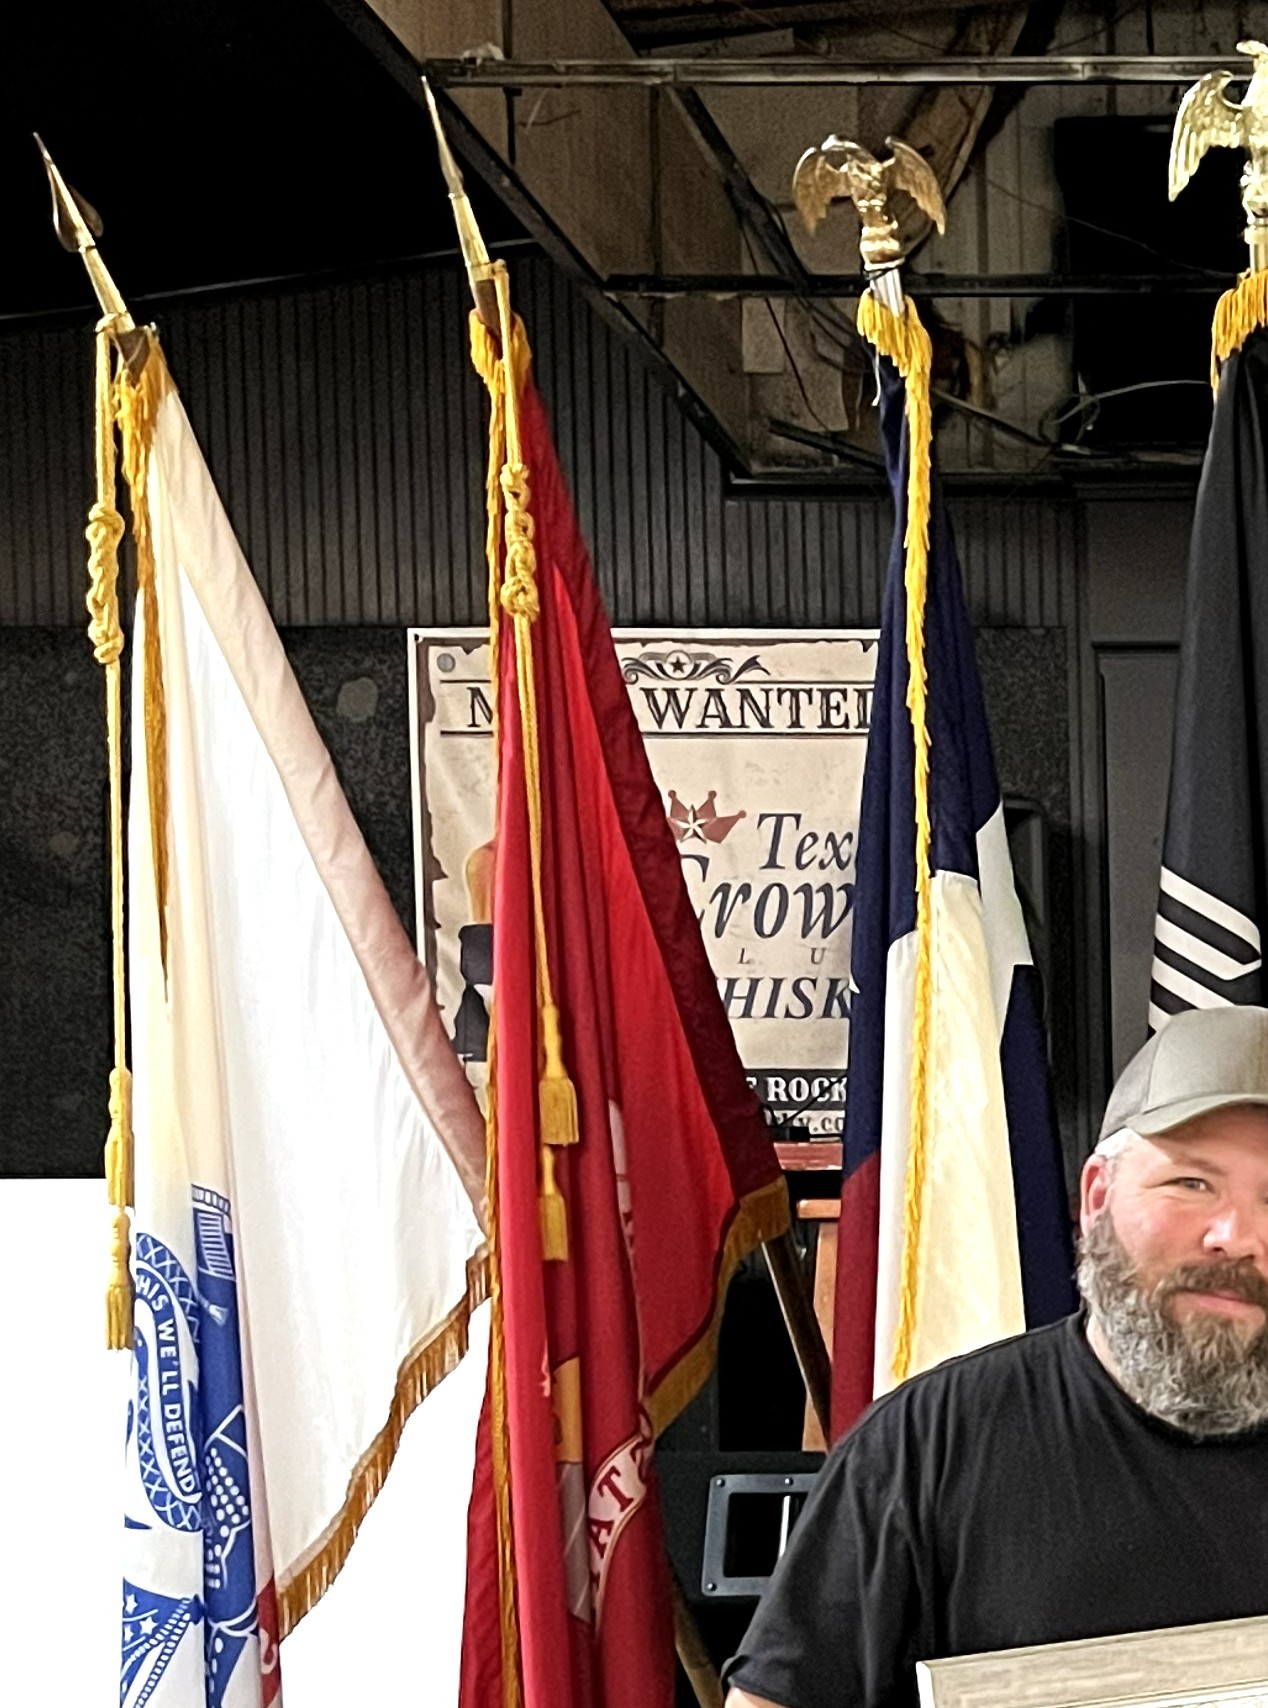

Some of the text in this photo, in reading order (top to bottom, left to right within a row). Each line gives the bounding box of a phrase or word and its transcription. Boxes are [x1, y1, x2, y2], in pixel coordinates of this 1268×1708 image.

[757, 813, 853, 871] Tex
[766, 1076, 848, 1102] ROCK
[157, 1319, 179, 1396] WE'LL
[164, 1402, 196, 1494] DEFEND
